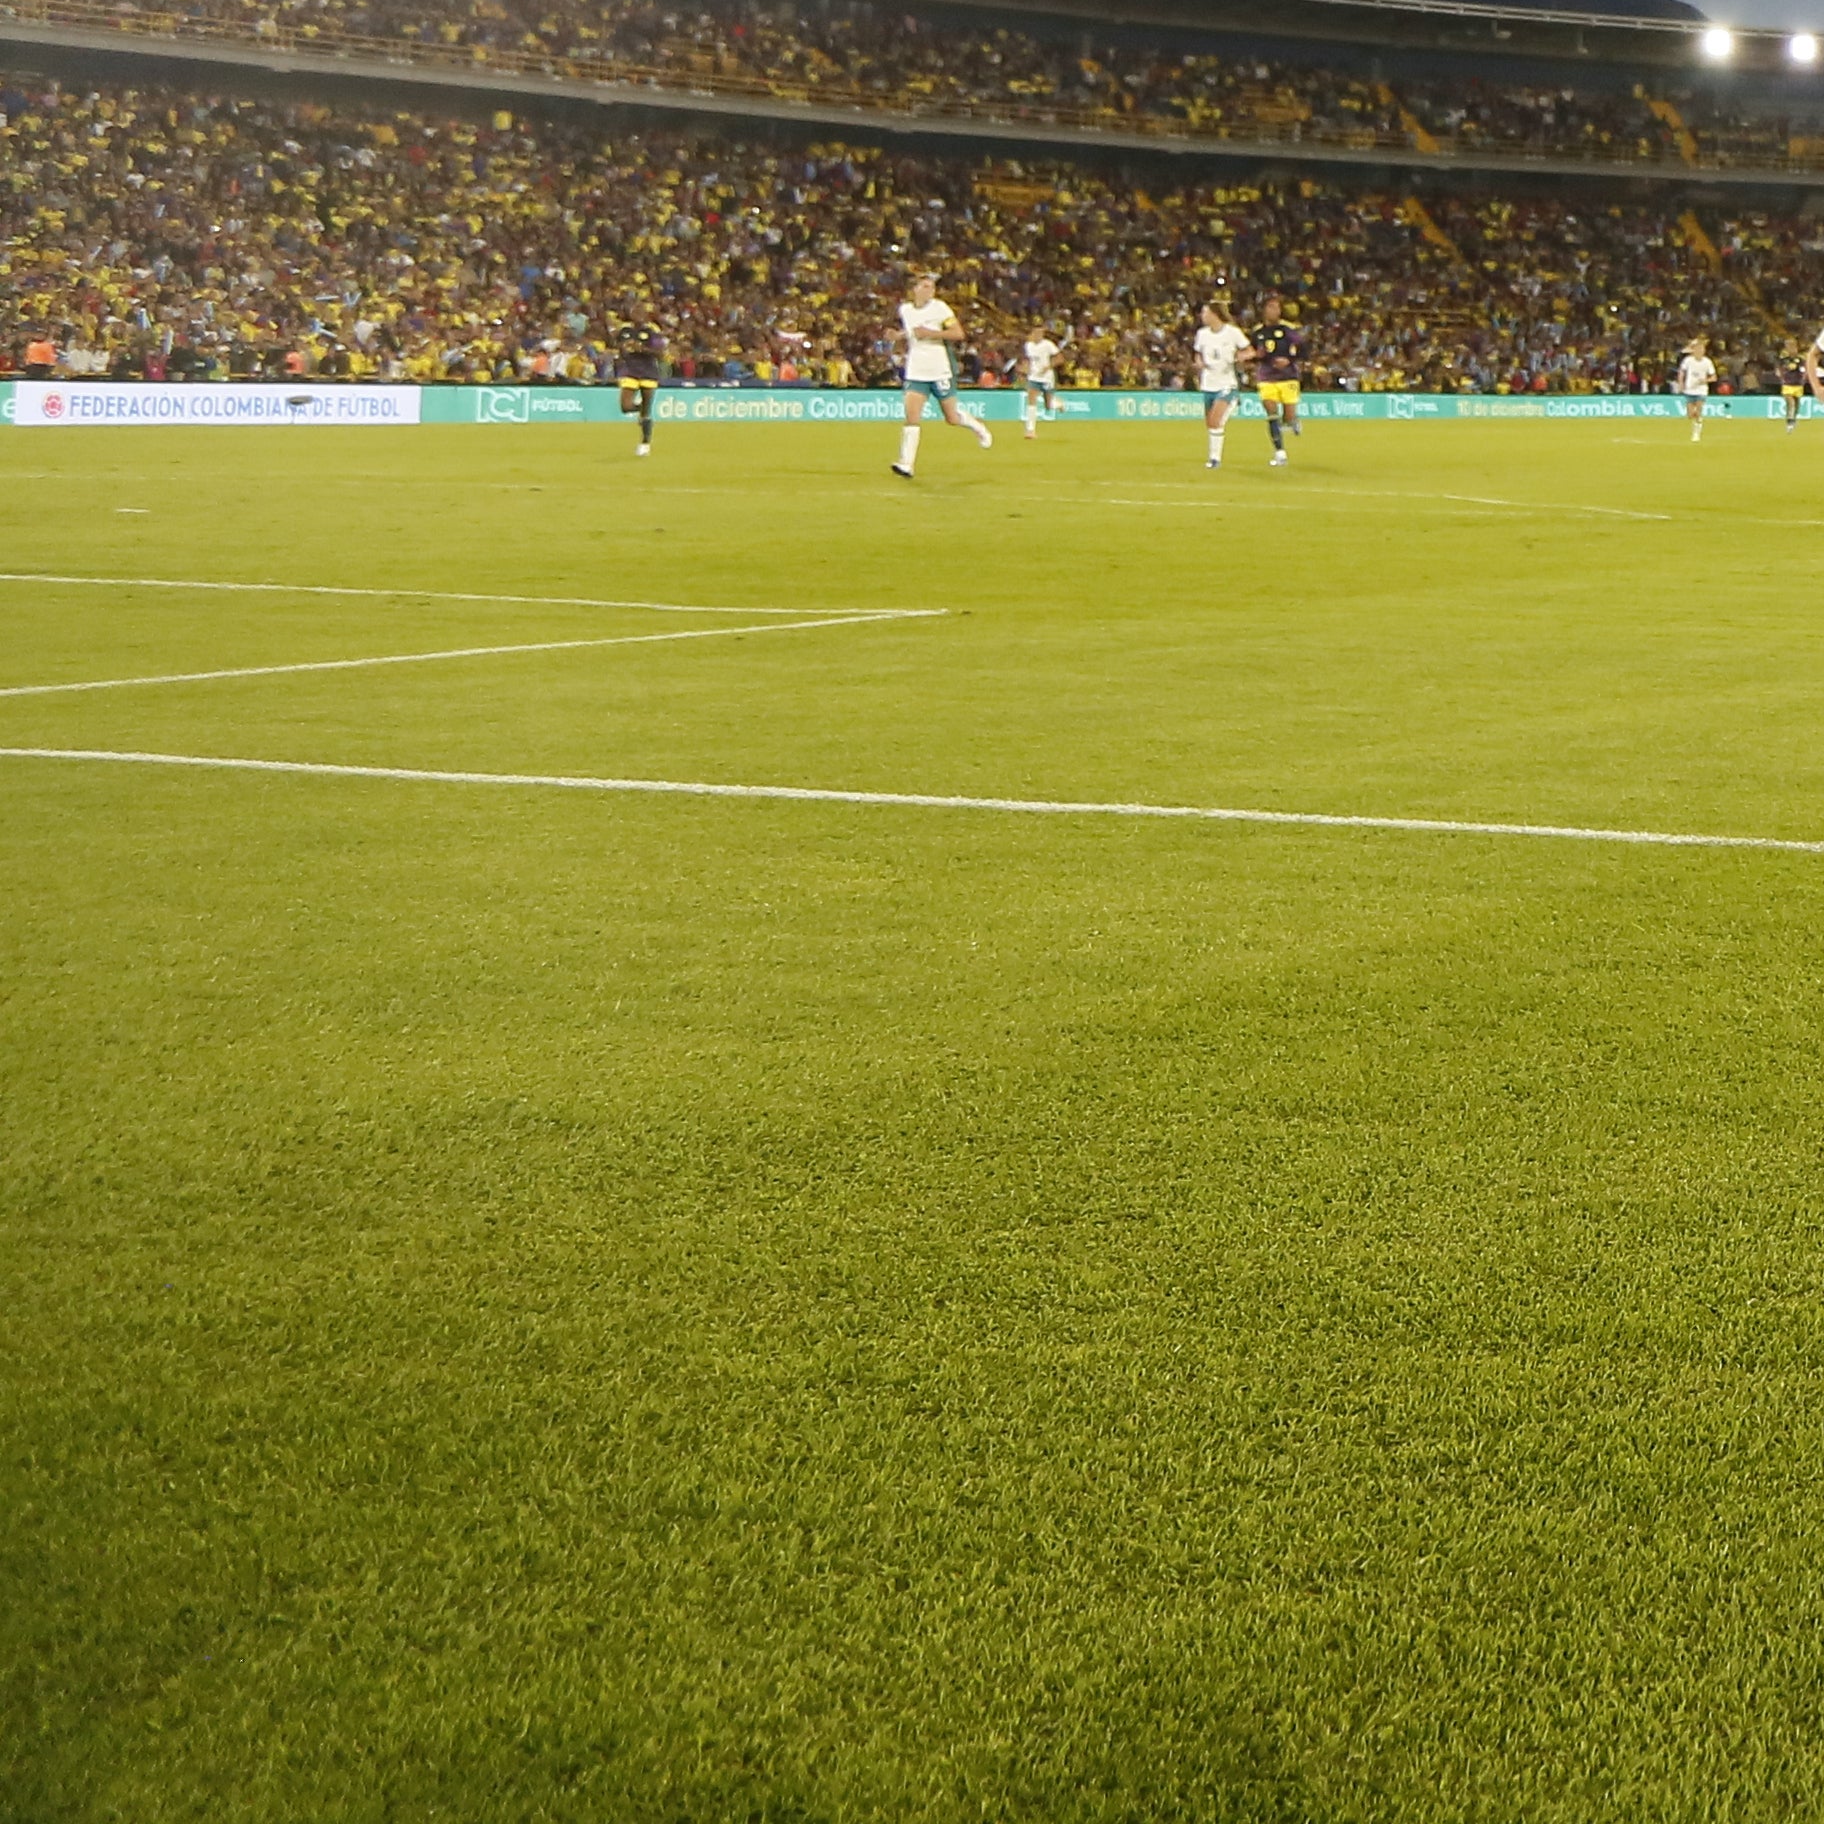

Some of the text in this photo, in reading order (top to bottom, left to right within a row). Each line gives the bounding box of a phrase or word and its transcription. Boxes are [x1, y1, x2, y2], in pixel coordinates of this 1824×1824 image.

[69, 391, 184, 417] FEDERACIÓN
[313, 396, 334, 417] DE
[338, 392, 400, 417] FÚTBOL
[658, 395, 688, 418] de
[692, 395, 803, 418] diciembre
[1639, 401, 1670, 417] vs.
